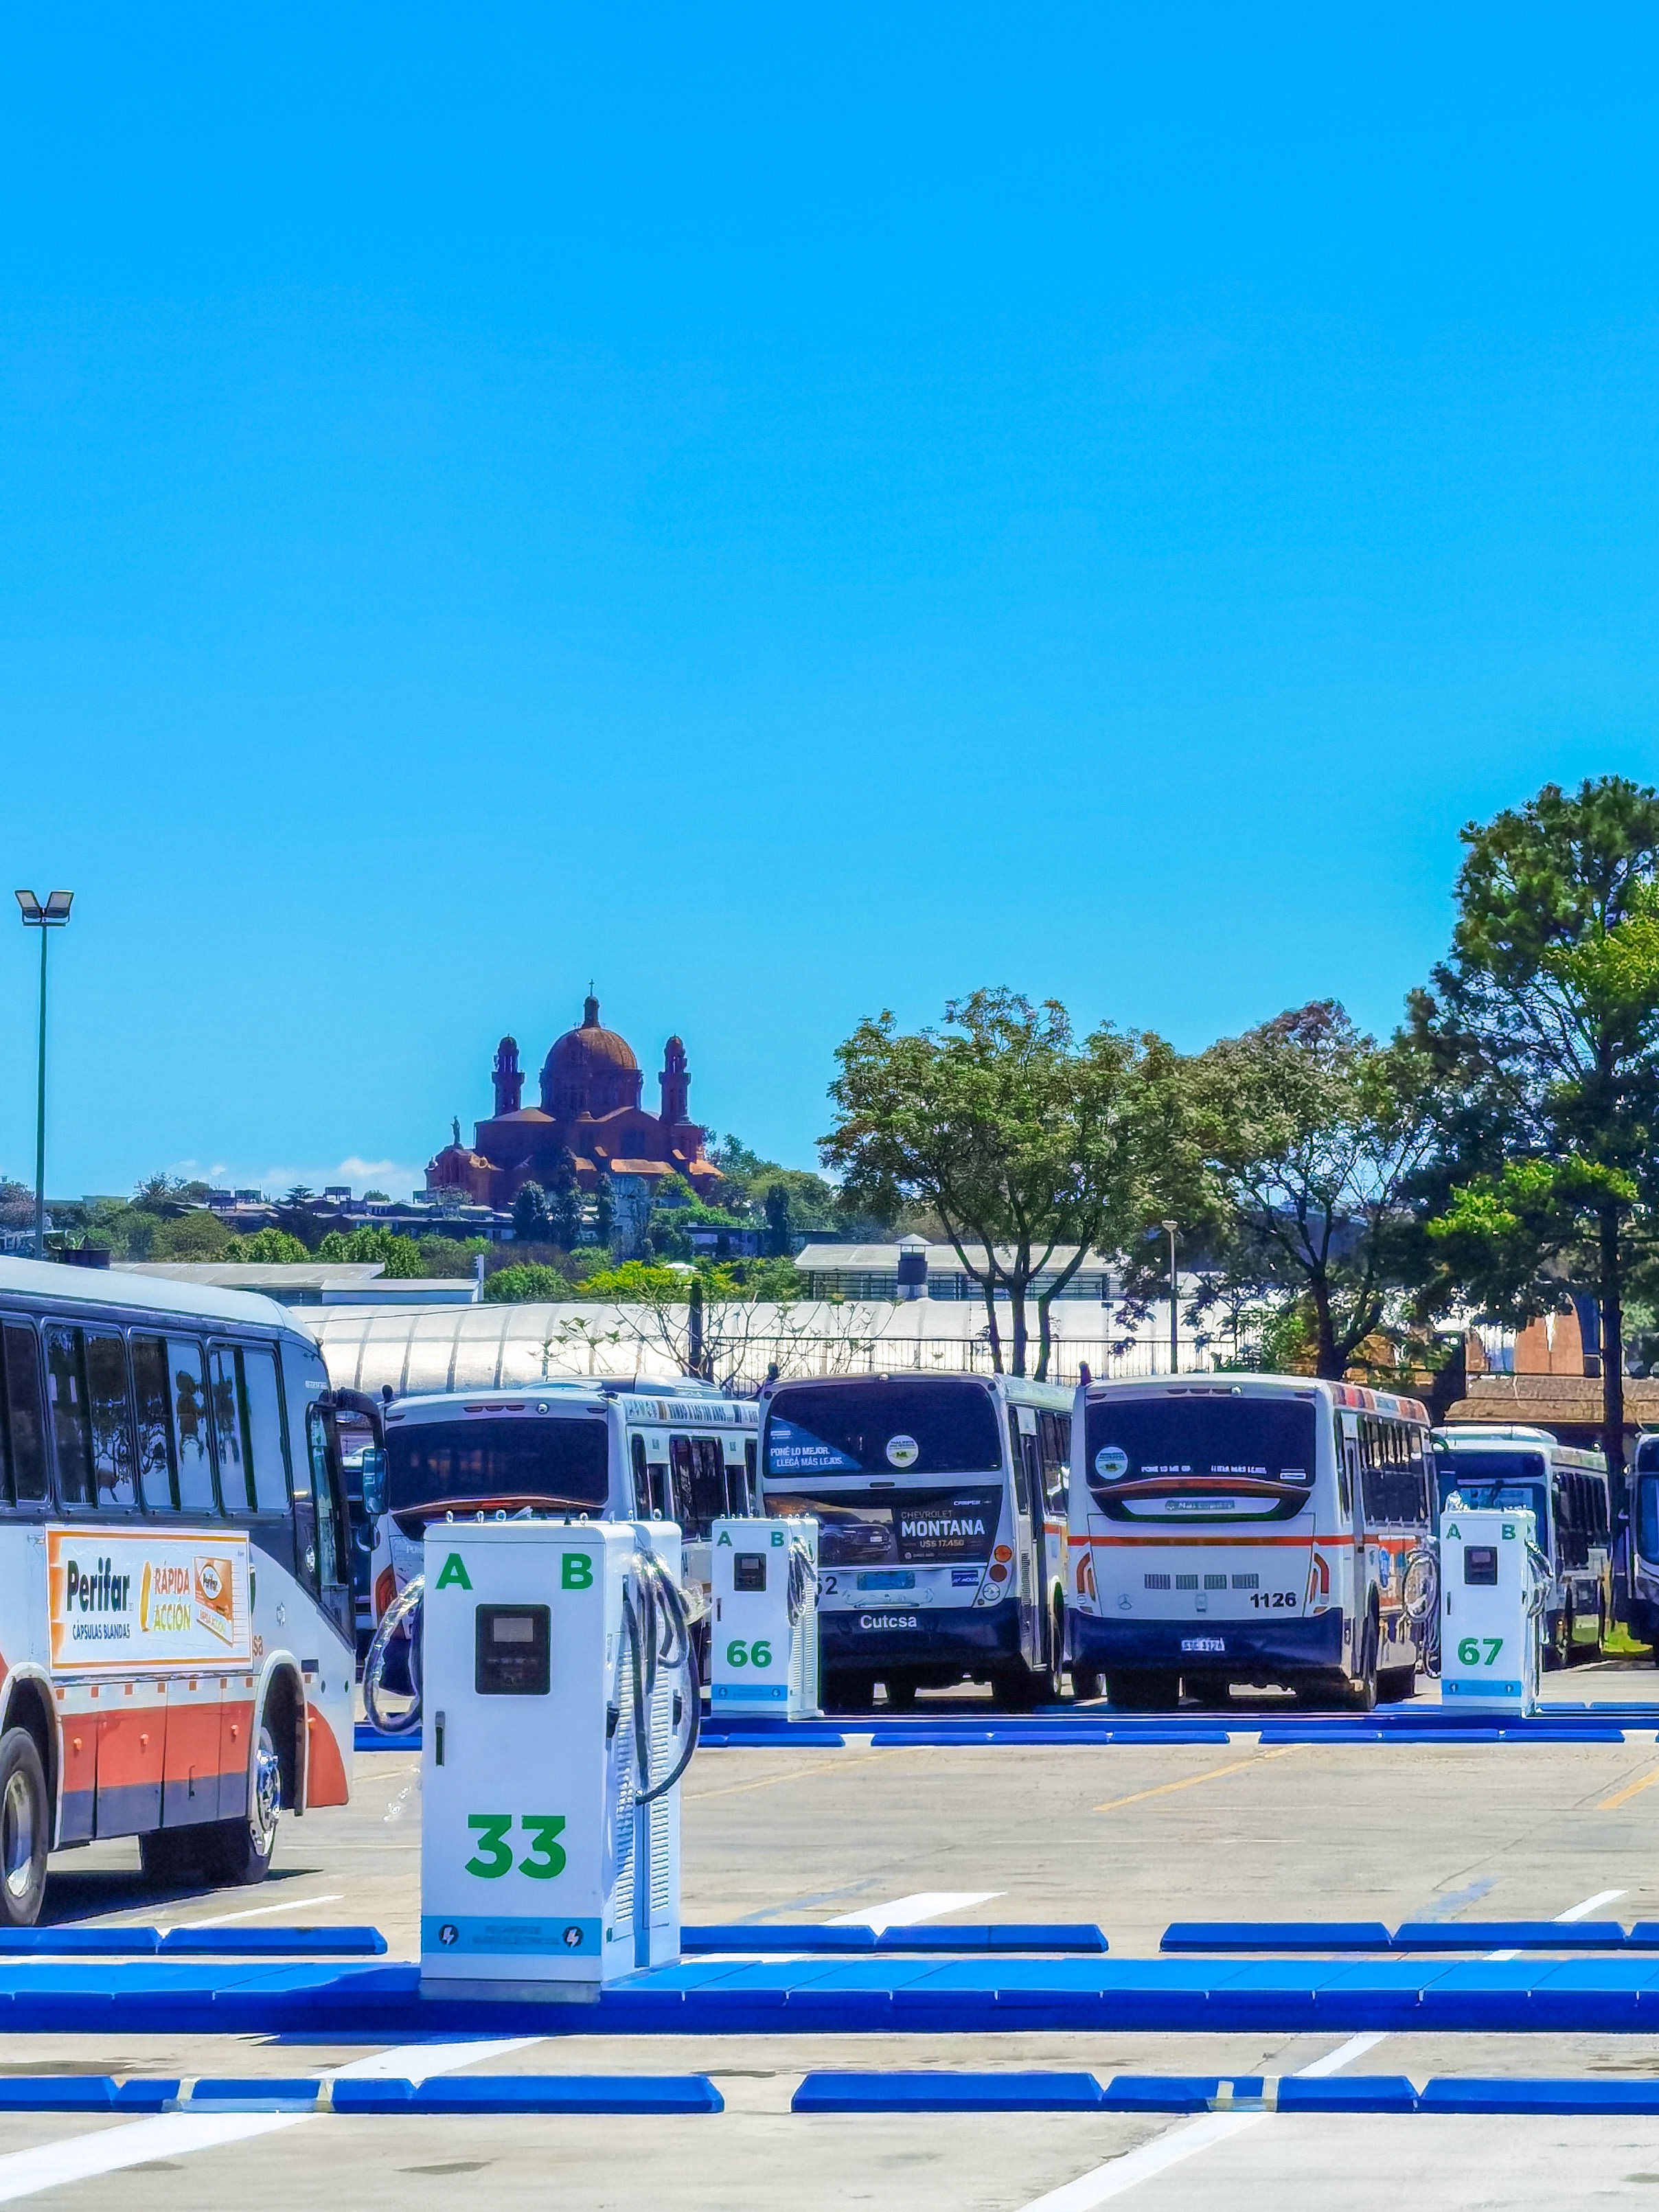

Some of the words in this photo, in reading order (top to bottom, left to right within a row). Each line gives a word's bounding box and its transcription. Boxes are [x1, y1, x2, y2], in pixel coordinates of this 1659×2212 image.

[791, 1447, 801, 1455] LO
[901, 1509, 952, 1519] CHEVROLET
[716, 1531, 733, 1547] A
[770, 1531, 784, 1547] B
[901, 1519, 985, 1538] MONTANA
[1446, 1523, 1461, 1540] A
[1502, 1523, 1515, 1540] B
[153, 1559, 190, 1595] RÁPIDA
[435, 1553, 473, 1590] A
[561, 1553, 593, 1590] B
[67, 1556, 130, 1612] Perifar
[1250, 1591, 1296, 1608] 1126
[153, 1595, 191, 1631] ACCIÓN
[860, 1615, 917, 1629] Cutcsa
[72, 1619, 103, 1640] CÁPSULAS
[104, 1623, 130, 1640] BLANDAS
[726, 1639, 773, 1668] 66
[1457, 1637, 1504, 1666] 67
[464, 1814, 567, 1880] 33
